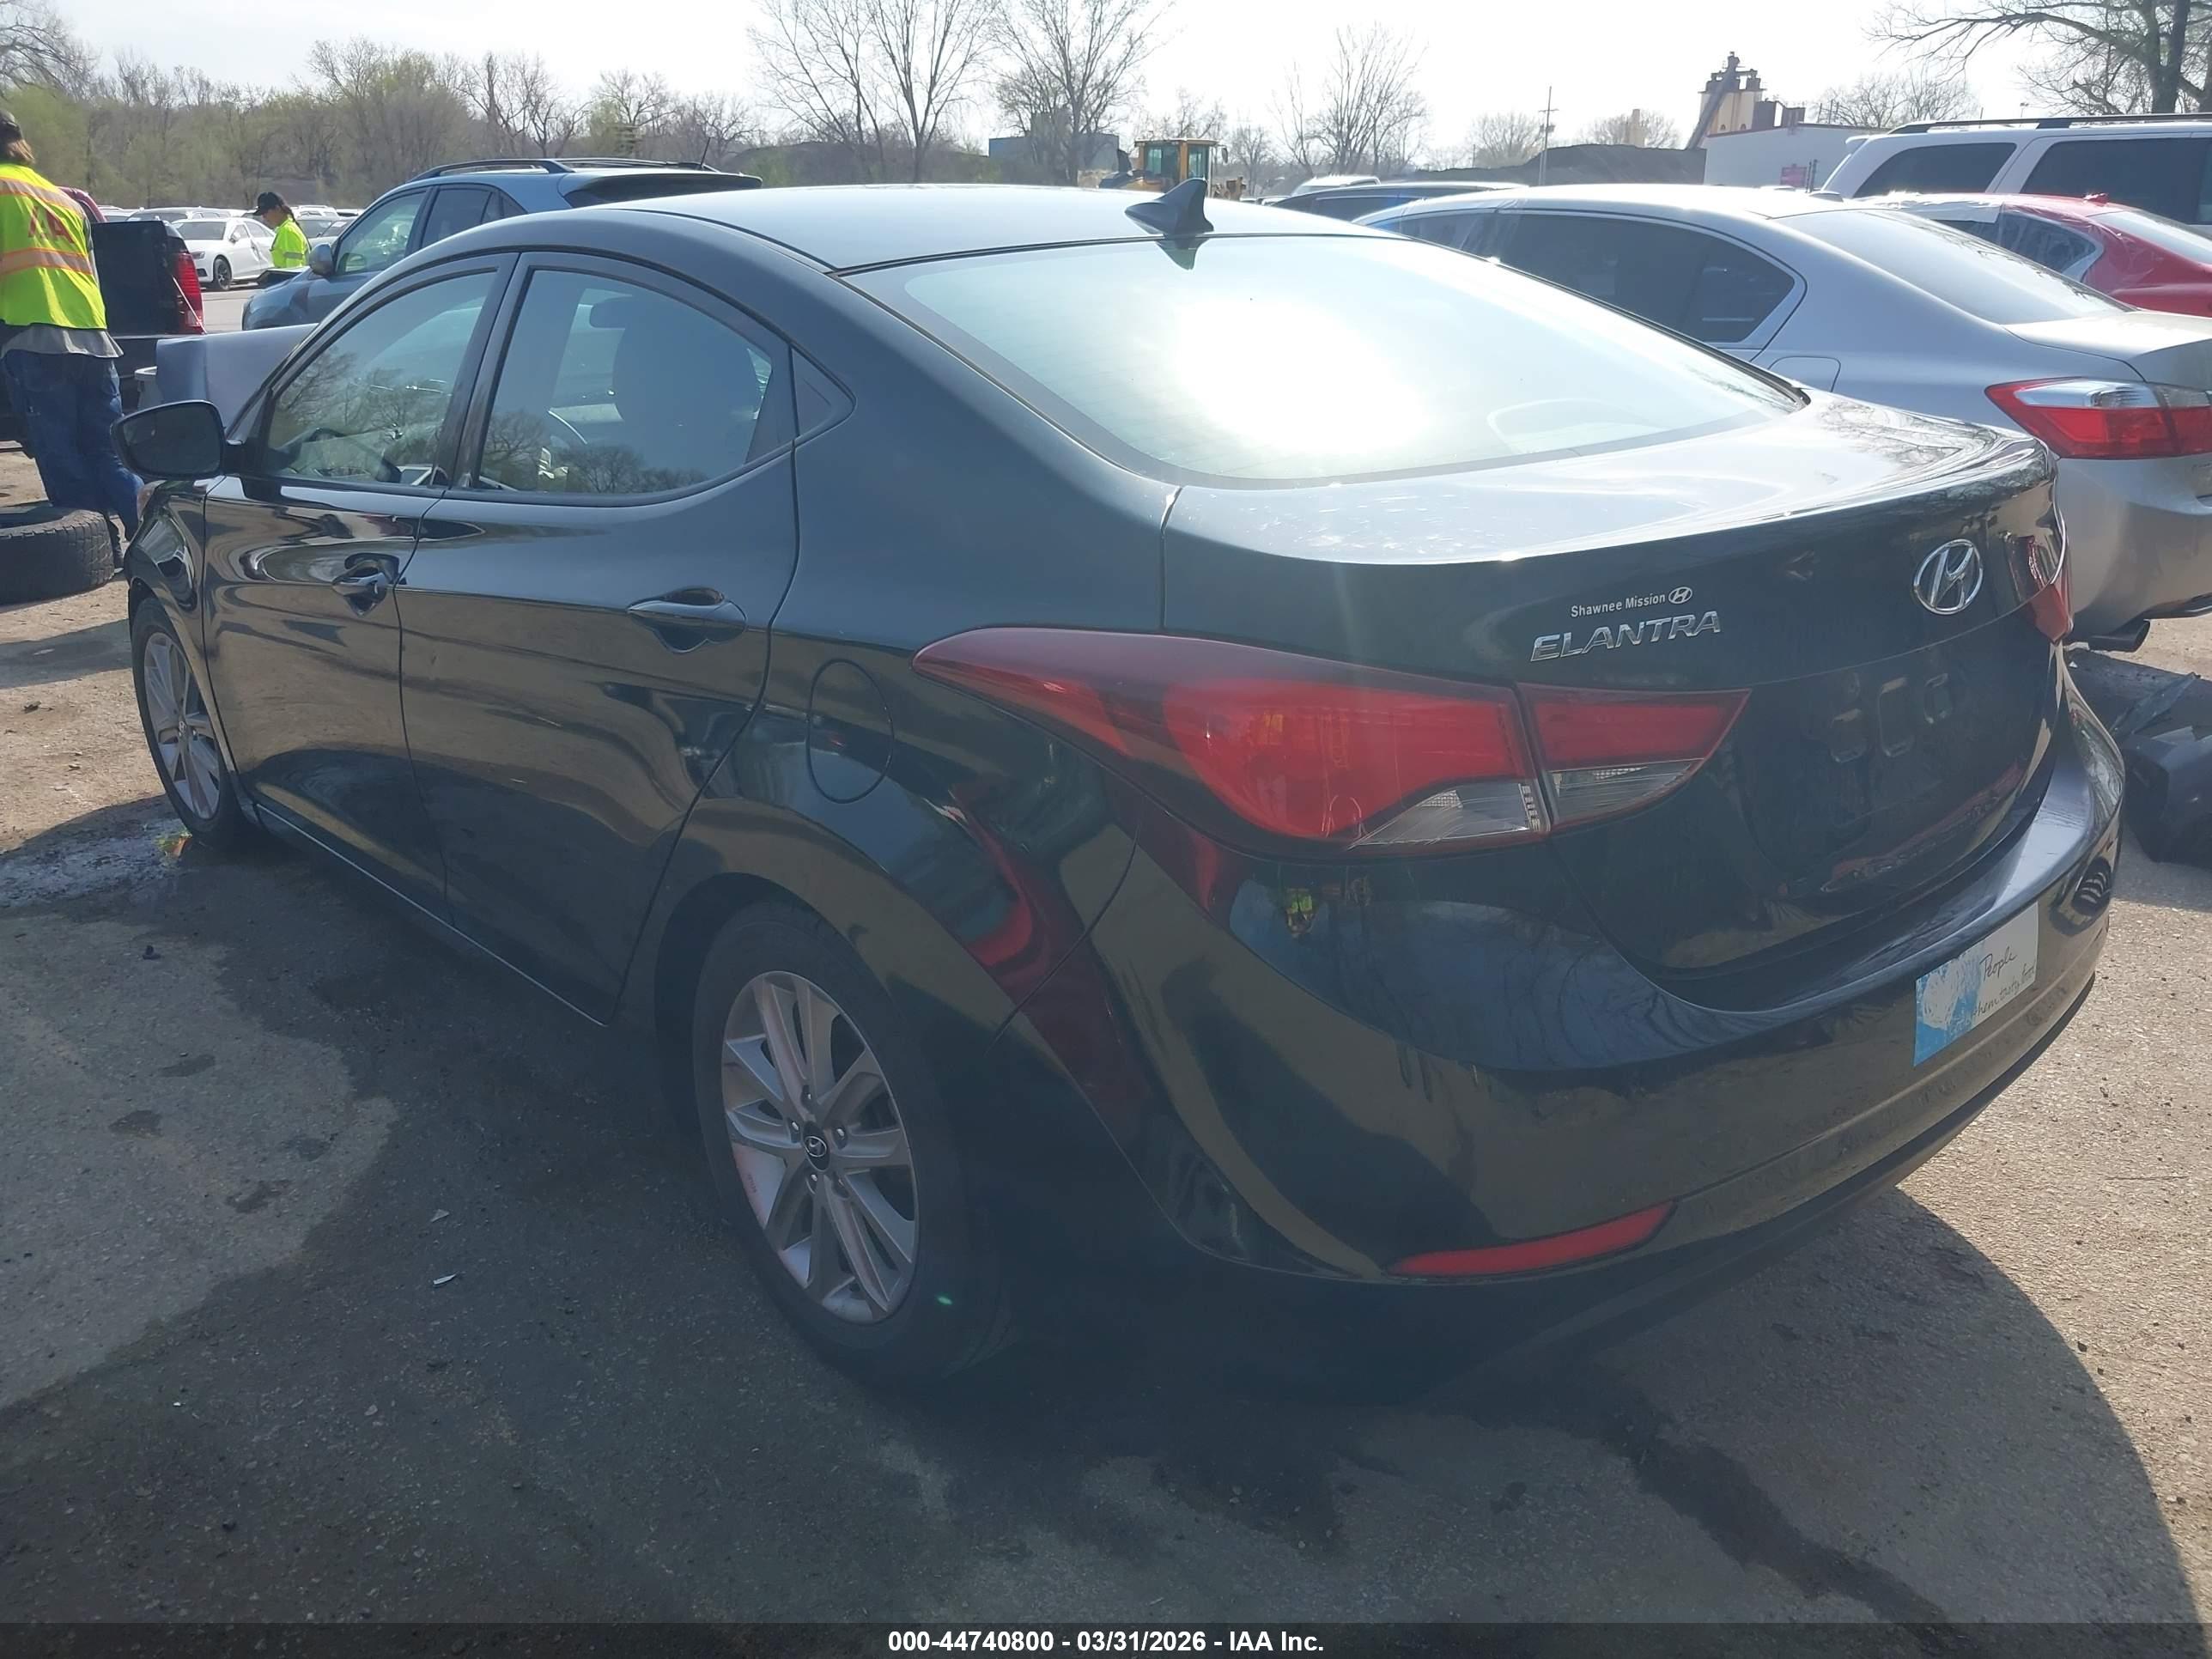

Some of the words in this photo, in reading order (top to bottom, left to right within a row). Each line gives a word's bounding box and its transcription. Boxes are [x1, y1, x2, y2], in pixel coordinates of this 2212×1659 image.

[1571, 602, 1623, 617] Shawnee
[1625, 593, 1666, 609] Mission
[1530, 611, 1721, 662] ELANTRA
[1979, 945, 2018, 982] People
